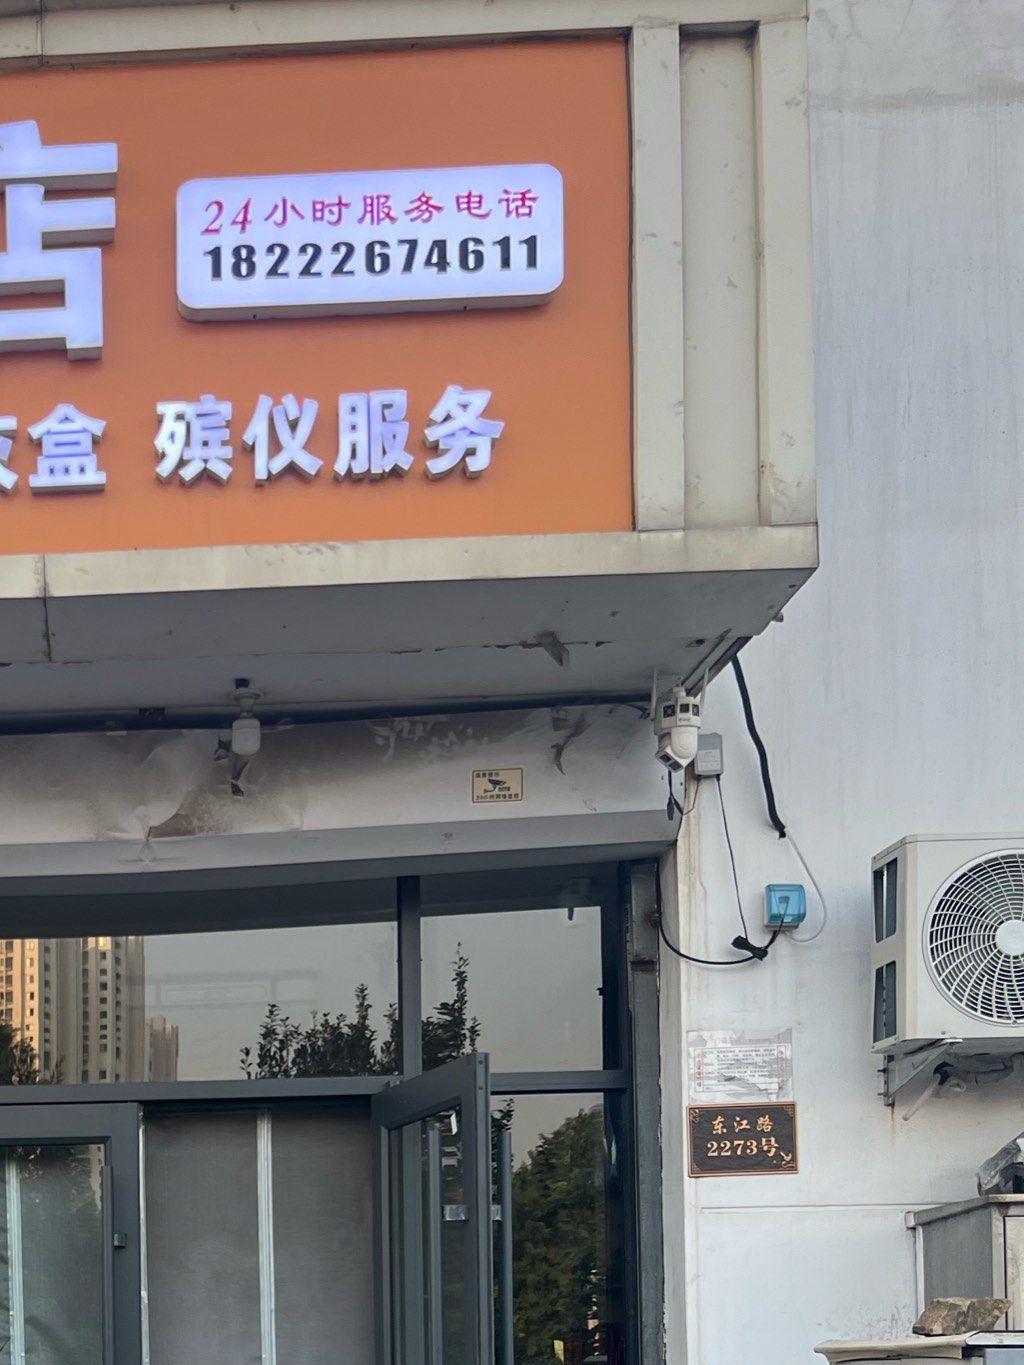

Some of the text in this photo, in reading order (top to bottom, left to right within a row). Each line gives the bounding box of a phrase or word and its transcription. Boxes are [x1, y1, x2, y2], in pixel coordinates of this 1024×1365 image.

[201, 188, 539, 235] 24小时服务电话
[204, 235, 540, 281] 18222674611
[154, 384, 506, 486] 殡仪服务
[706, 1136, 779, 1157] 2273号
[711, 1114, 774, 1135] 东江路
